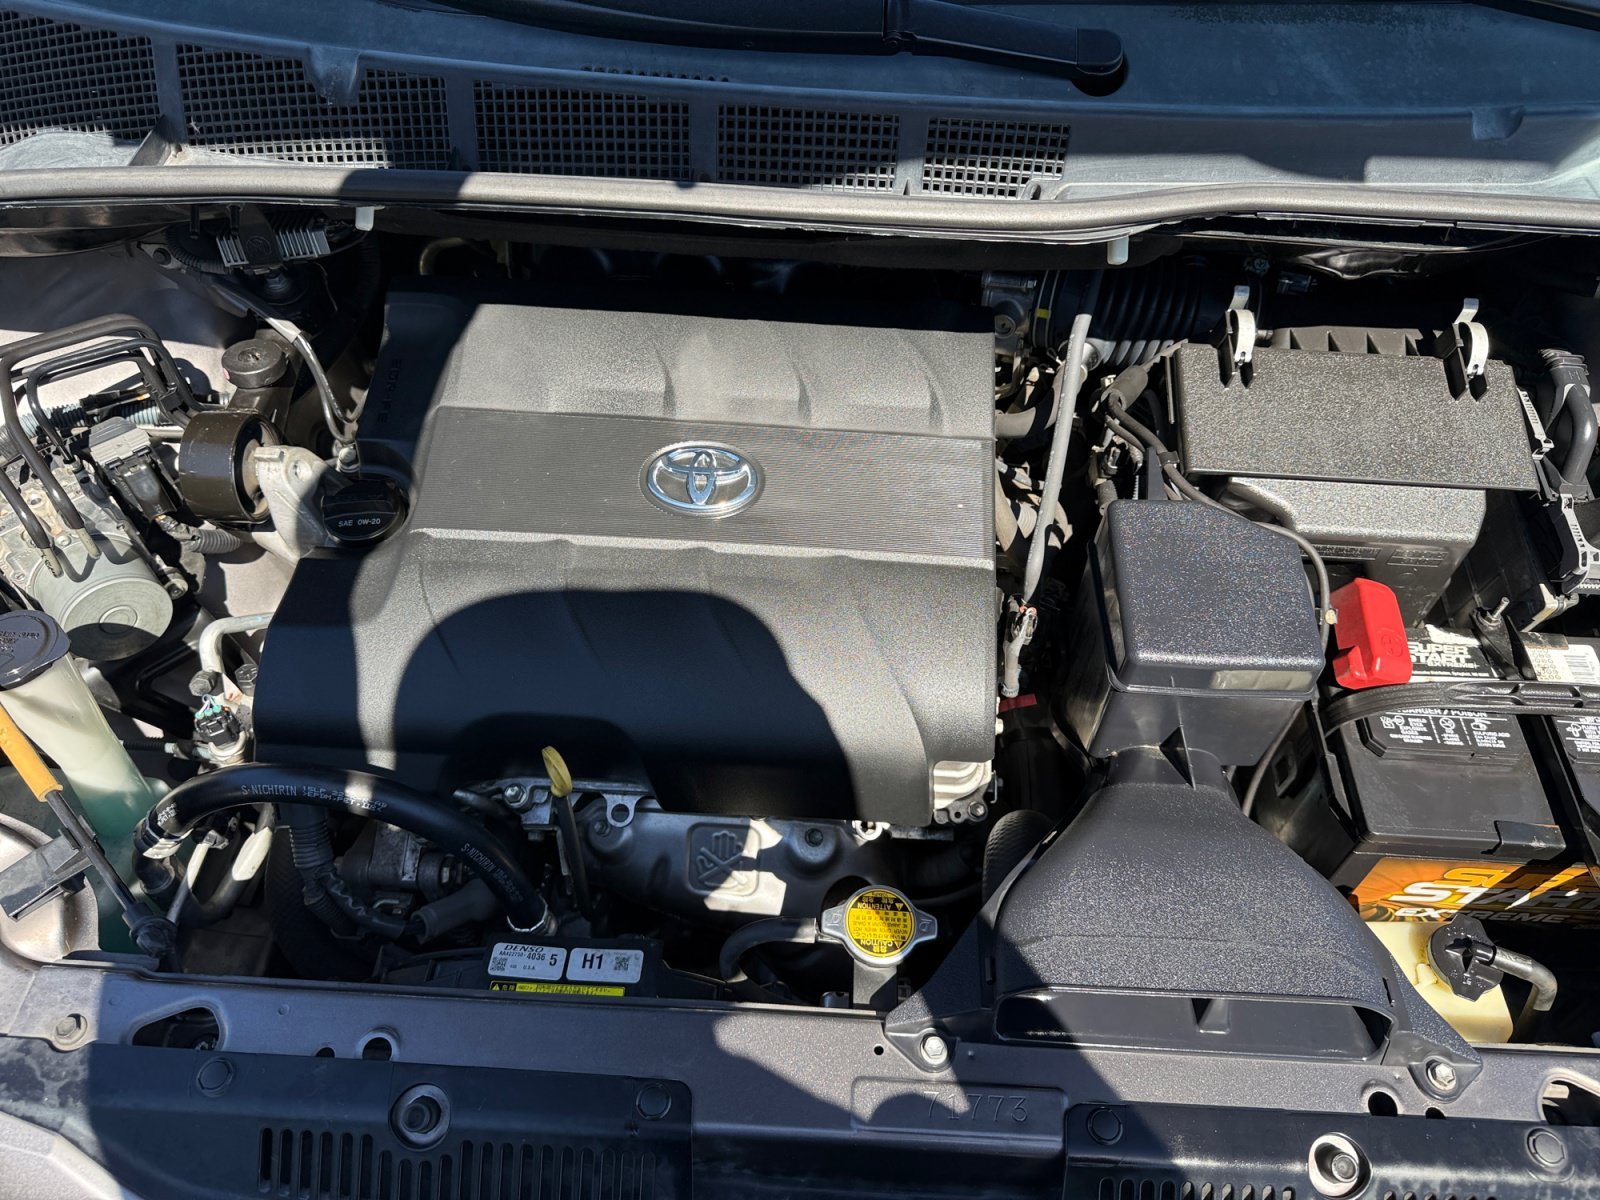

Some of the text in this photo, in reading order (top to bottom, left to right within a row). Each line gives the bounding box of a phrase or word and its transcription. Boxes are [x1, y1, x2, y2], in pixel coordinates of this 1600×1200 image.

[338, 517, 381, 528] SAE 0W-20
[1407, 641, 1468, 655] SUPER
[857, 902, 892, 910] ATTENTION
[504, 944, 544, 953] DENSO
[860, 939, 893, 947] CAUTION
[549, 953, 559, 967] 5
[581, 952, 604, 970] H1
[924, 1091, 1028, 1122] 71773
